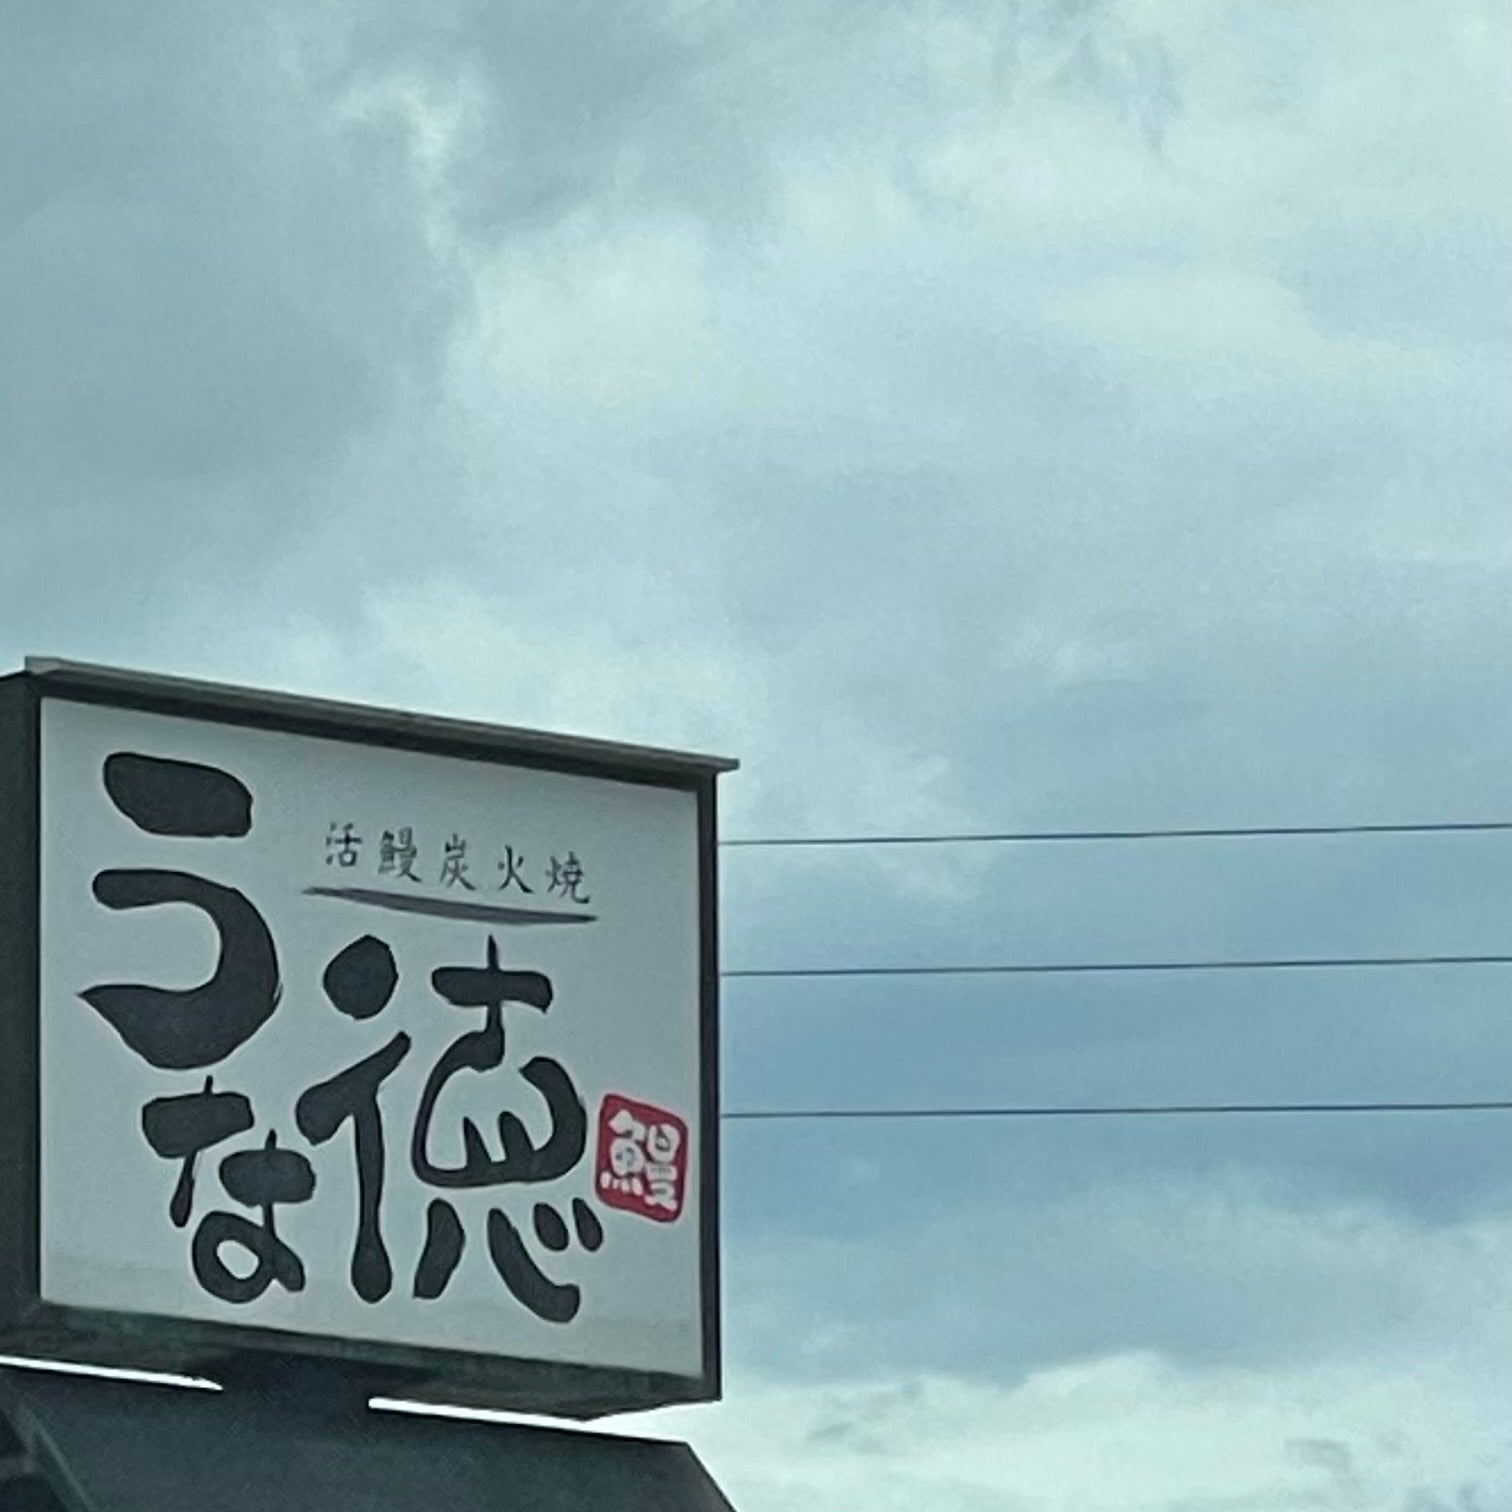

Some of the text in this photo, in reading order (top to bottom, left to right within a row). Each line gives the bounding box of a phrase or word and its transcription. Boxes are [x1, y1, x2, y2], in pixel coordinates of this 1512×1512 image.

[325, 822, 591, 903] 活鰻炭火焼
